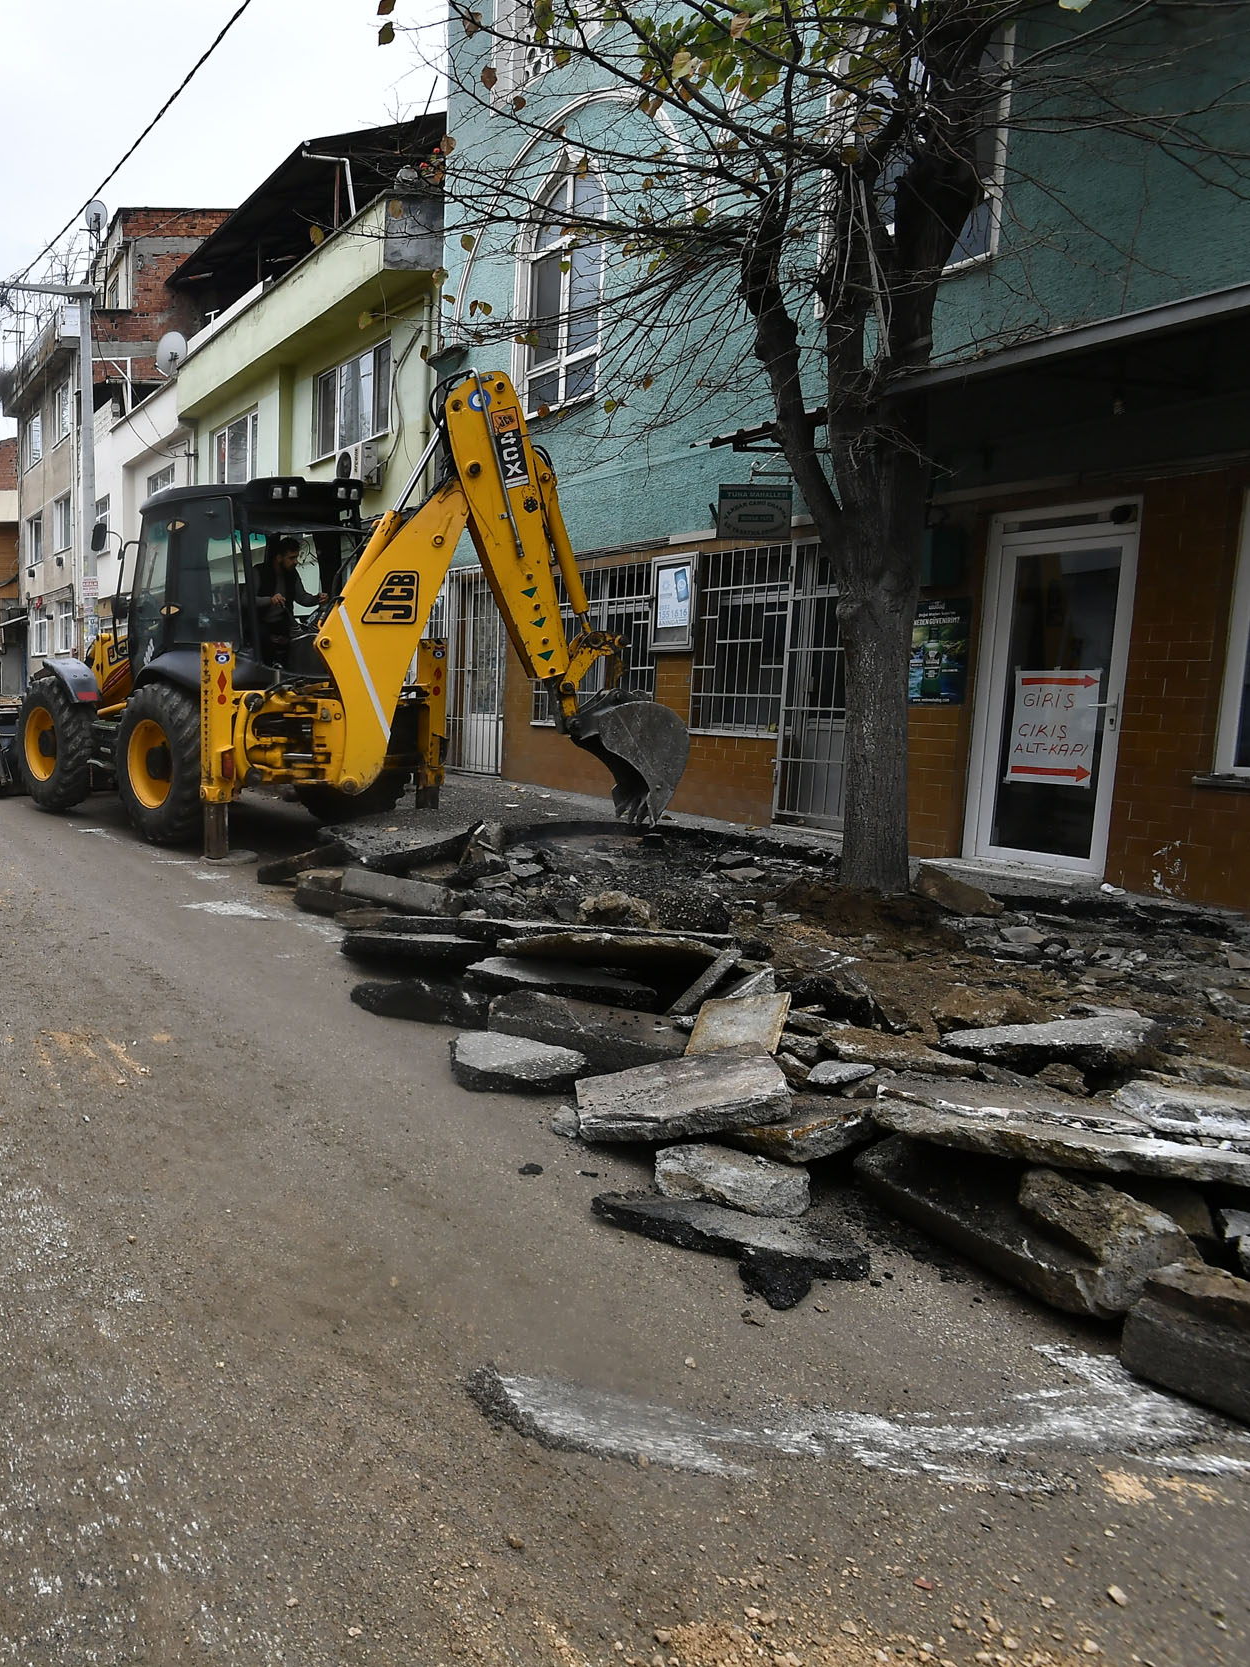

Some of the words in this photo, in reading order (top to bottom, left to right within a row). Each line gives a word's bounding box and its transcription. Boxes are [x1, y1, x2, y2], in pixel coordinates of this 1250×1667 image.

[498, 414, 514, 428] JCB
[500, 431, 524, 477] 4CX
[369, 574, 416, 620] JCB
[680, 608, 688, 617] 16
[913, 618, 929, 626] NEDEN
[1023, 687, 1075, 711] GİRİŞ
[1018, 723, 1068, 741] ÇIKIŞ
[1013, 742, 1089, 757] ALT-KAPI
